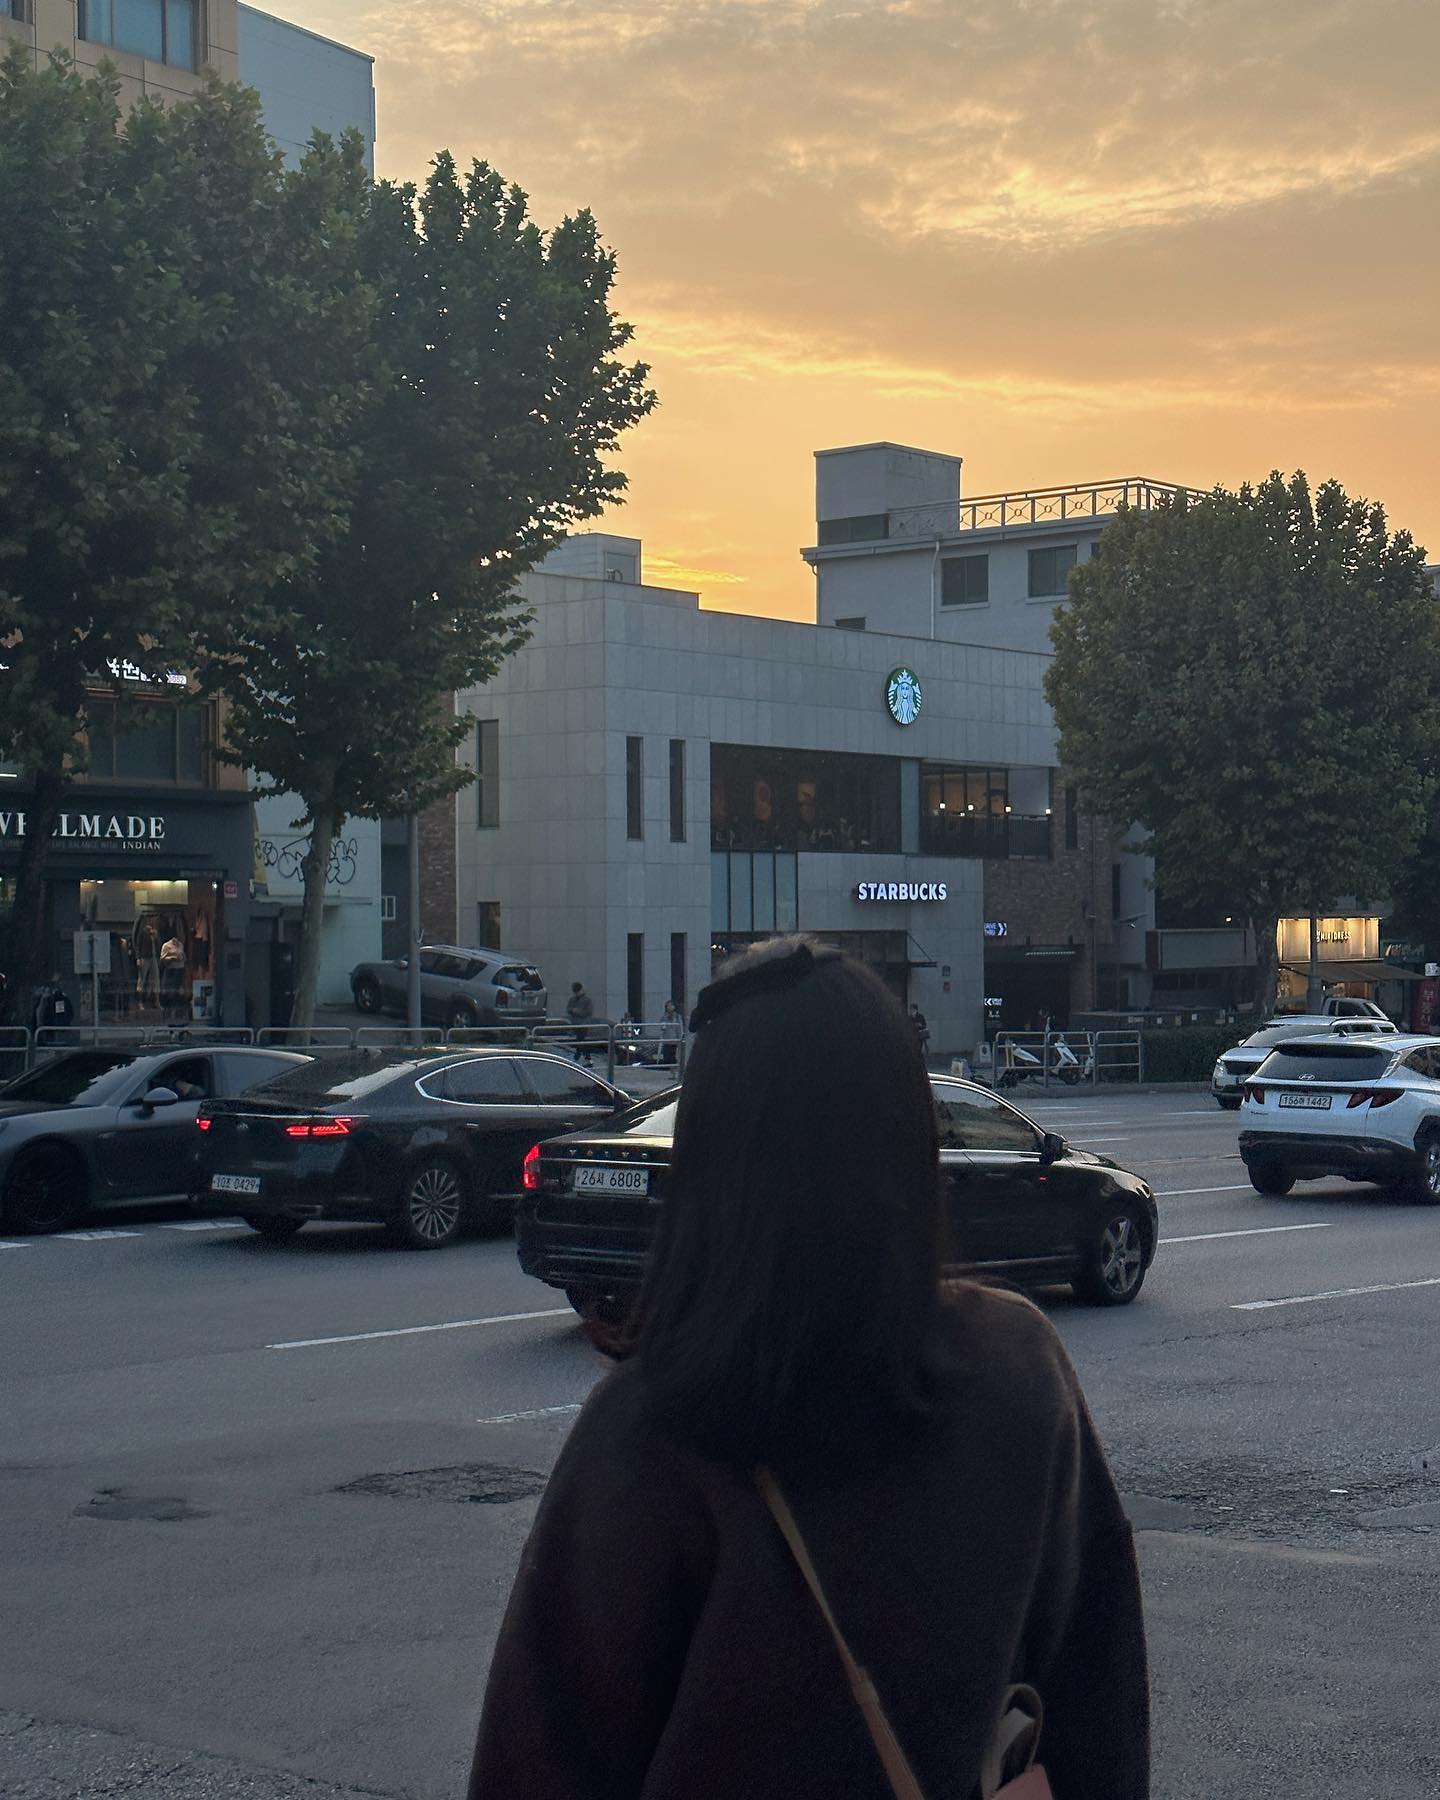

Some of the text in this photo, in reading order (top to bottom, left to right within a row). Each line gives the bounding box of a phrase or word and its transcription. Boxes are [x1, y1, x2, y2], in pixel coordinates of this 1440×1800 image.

[0, 811, 165, 839] ELMADE
[121, 841, 161, 850] INDIAN
[858, 882, 947, 900] STARBUCKS
[609, 1171, 641, 1188] 6808
